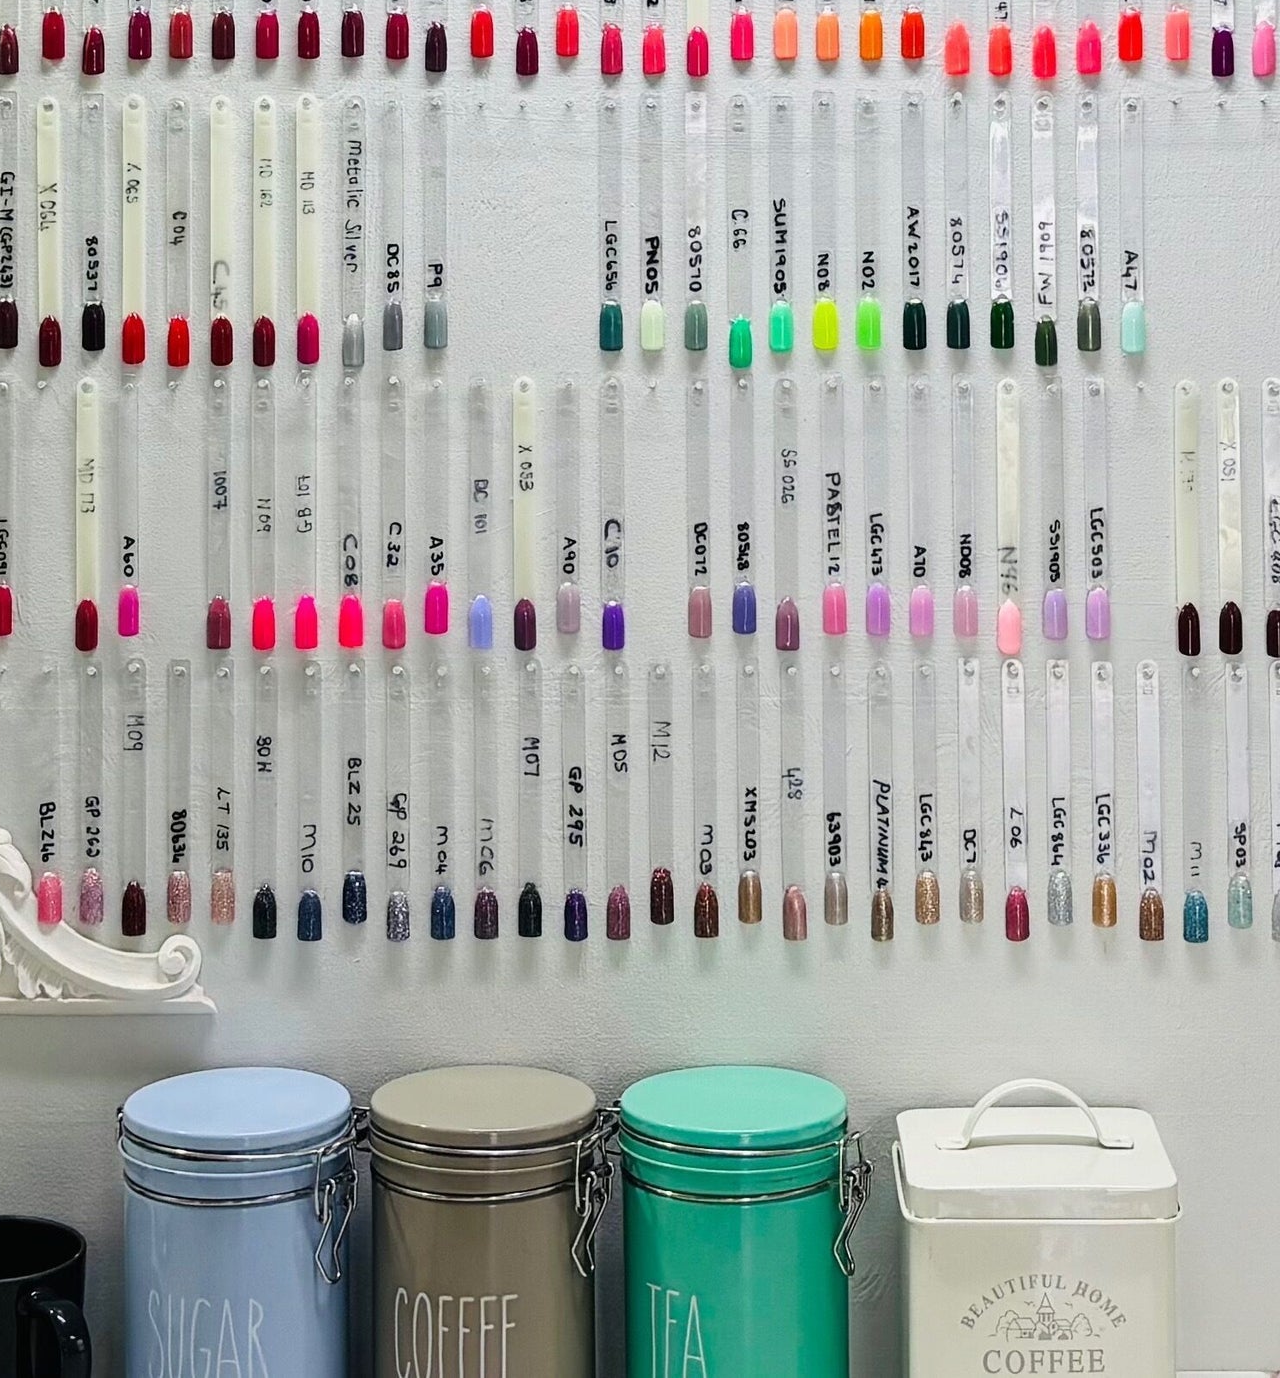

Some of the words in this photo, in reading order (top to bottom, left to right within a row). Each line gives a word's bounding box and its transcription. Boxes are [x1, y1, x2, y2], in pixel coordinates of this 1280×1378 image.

[604, 219, 618, 292] LGC656
[645, 235, 660, 295] PN05
[687, 224, 703, 293] 80570
[861, 250, 875, 291] N02
[907, 206, 921, 288] AW2017
[1121, 249, 1139, 292] A47
[429, 535, 444, 575] A35
[563, 536, 577, 575] A90
[693, 521, 708, 577] DC072
[736, 521, 750, 571] 80548
[958, 533, 972, 579] ND08
[1089, 507, 1104, 579] LGC503
[826, 811, 842, 867] 63903
[963, 828, 978, 864] DC7
[1051, 797, 1066, 866] LGC864
[960, 1273, 1066, 1330] BEAUTIFUL
[1071, 1279, 1128, 1329] HOME
[982, 1348, 1106, 1375] COFFEE
